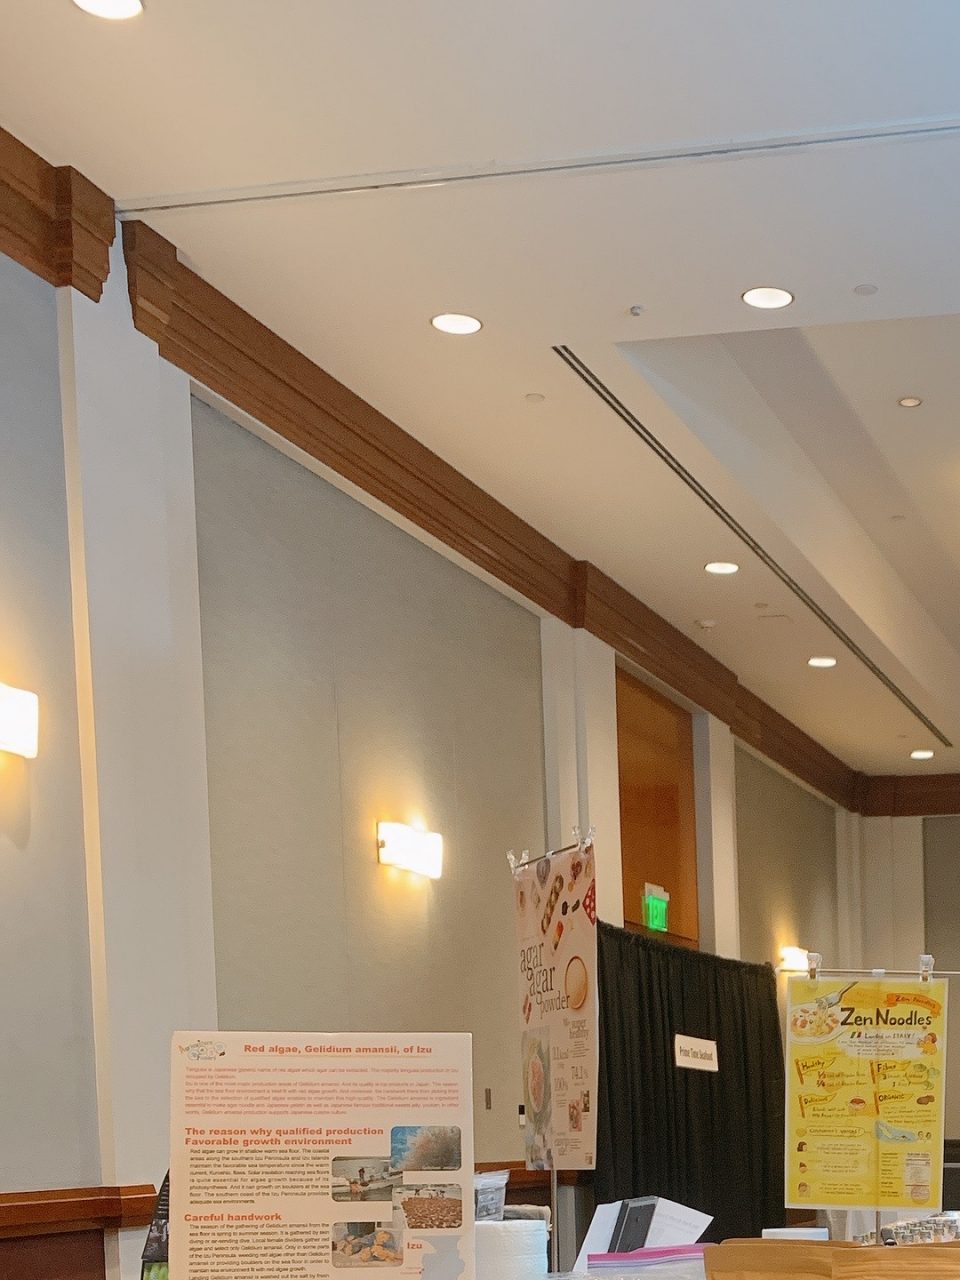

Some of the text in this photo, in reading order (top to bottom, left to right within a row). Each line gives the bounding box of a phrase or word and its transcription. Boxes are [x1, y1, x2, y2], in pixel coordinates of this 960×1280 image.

[520, 942, 544, 981] agar
[529, 966, 556, 1005] agar
[540, 990, 570, 1020] powder
[840, 1007, 932, 1026] Zen Noodles
[244, 1044, 265, 1053] Red
[268, 1044, 301, 1054] algae,
[304, 1045, 352, 1053] Gelidium
[403, 1045, 414, 1053] of
[416, 1045, 432, 1053] Izu
[185, 1127, 384, 1137] The reason why qualified production
[185, 1137, 352, 1147] Favorable growth environment
[184, 1213, 282, 1222] Careful handwork
